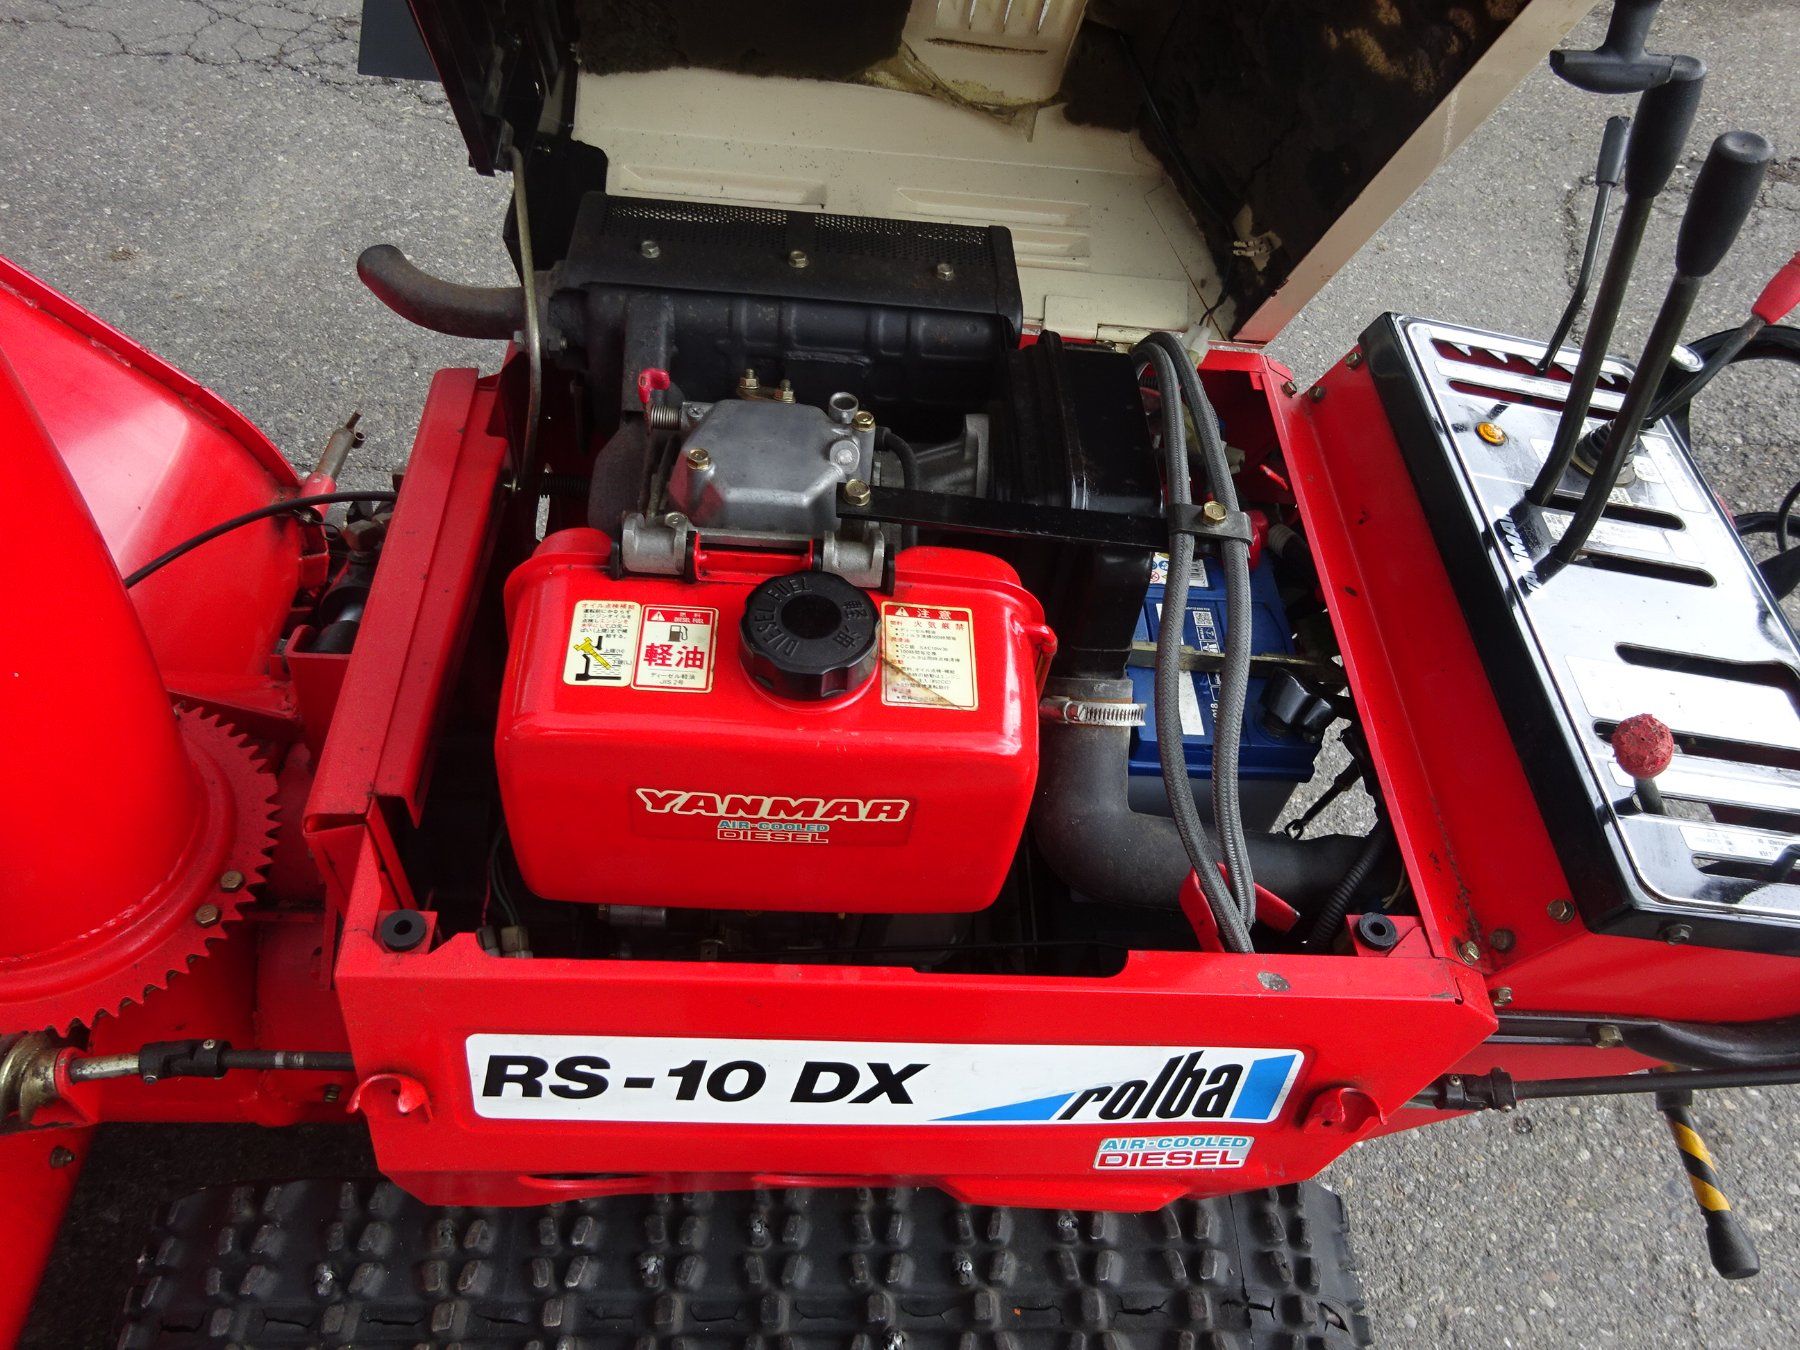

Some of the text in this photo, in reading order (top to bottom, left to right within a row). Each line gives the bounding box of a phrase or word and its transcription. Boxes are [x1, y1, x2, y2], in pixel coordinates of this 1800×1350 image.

[755, 577, 813, 657] DIESEL FUEL
[917, 608, 952, 619] 注意
[644, 643, 705, 669] 軽油
[636, 788, 910, 821] YANMAR
[717, 820, 829, 832] AIR-COOLED
[717, 830, 828, 843] DIESEL
[790, 1061, 931, 1104] DX
[1057, 1050, 1243, 1120] rolba
[1102, 1137, 1248, 1150] AIR-COOLED
[1099, 1150, 1241, 1167] DIESEL
